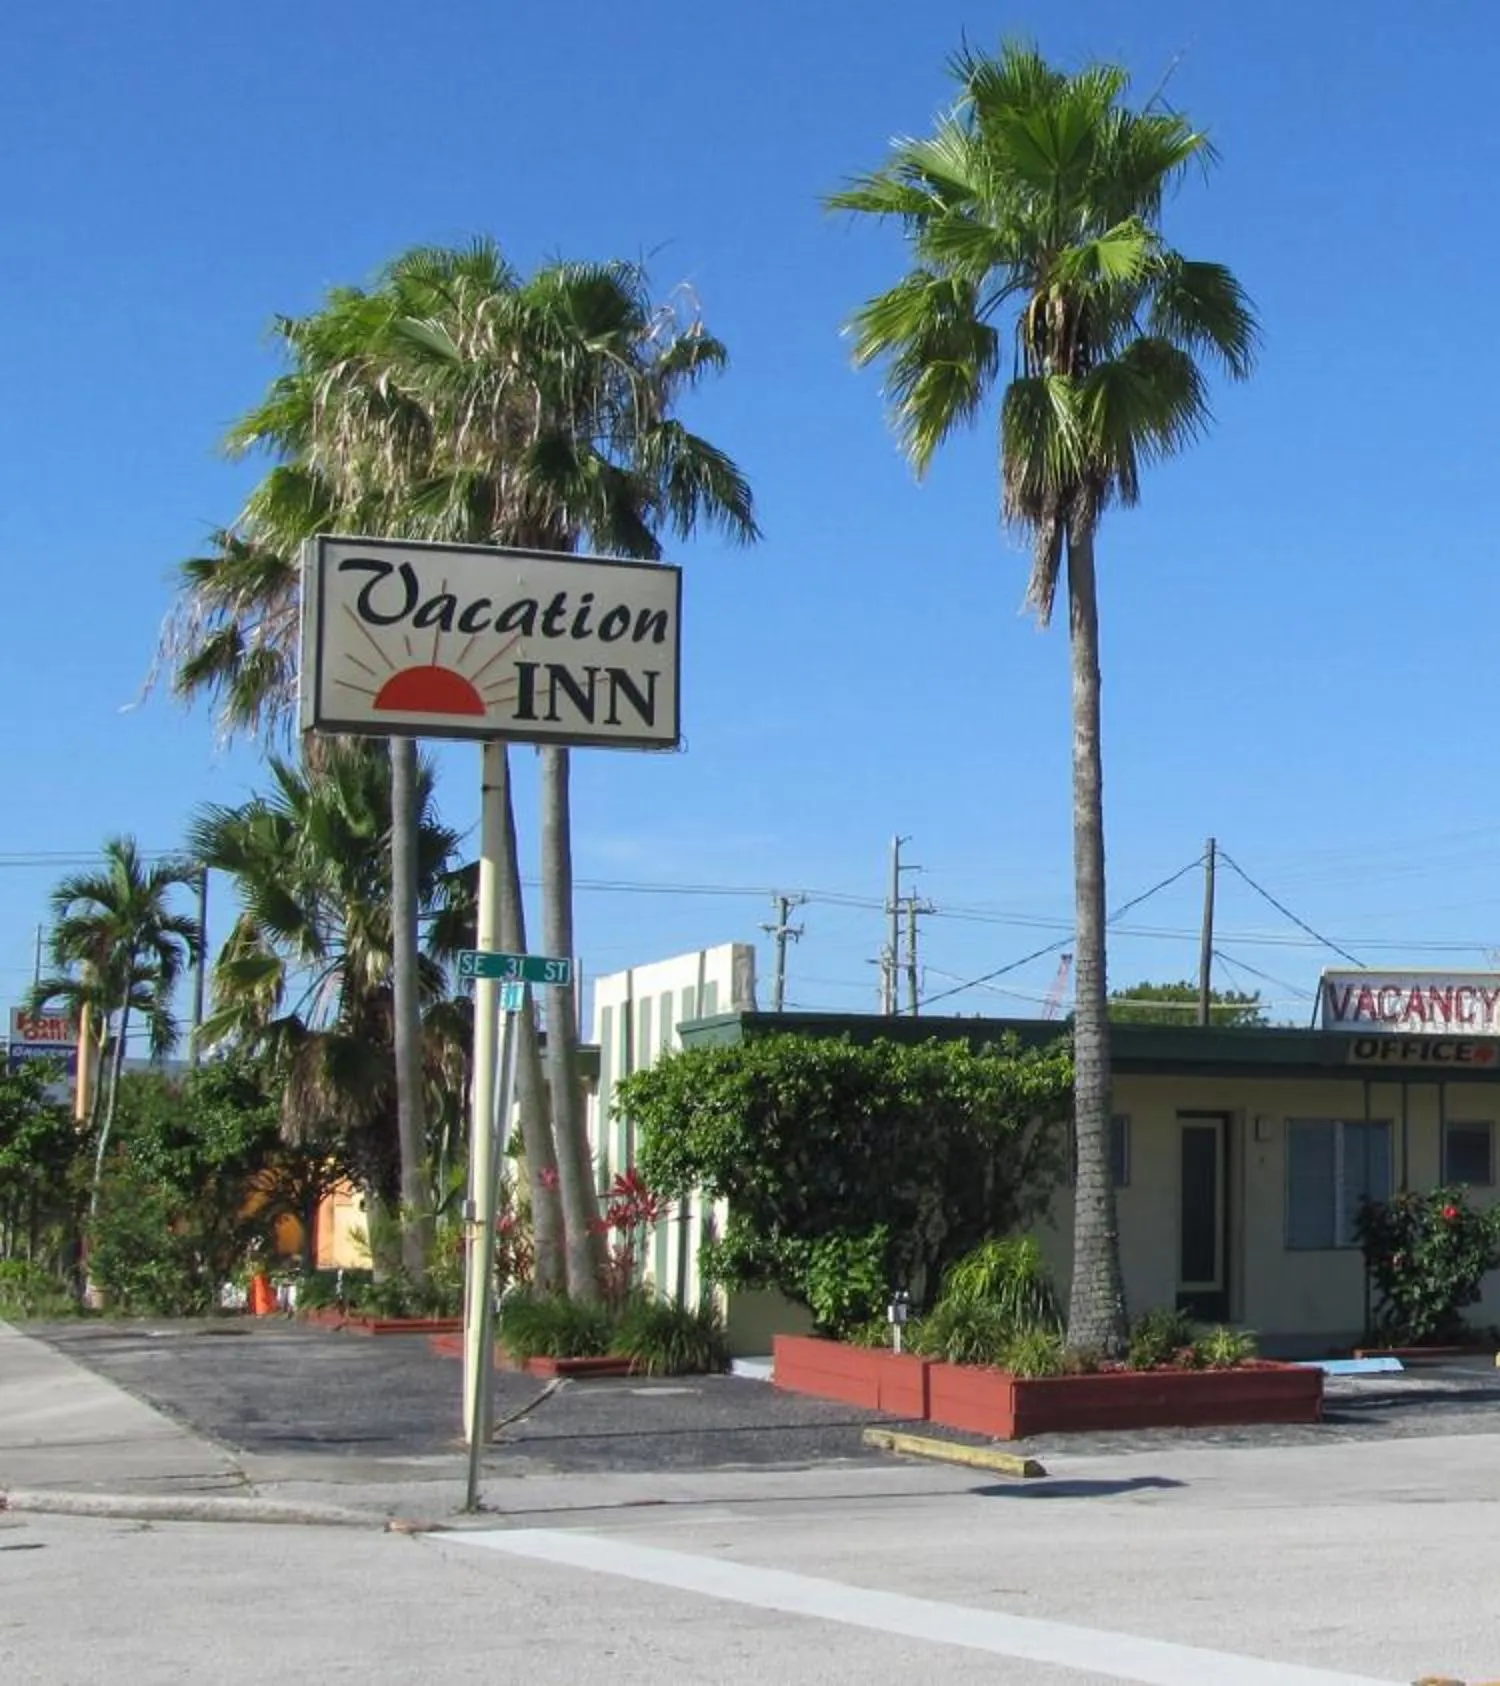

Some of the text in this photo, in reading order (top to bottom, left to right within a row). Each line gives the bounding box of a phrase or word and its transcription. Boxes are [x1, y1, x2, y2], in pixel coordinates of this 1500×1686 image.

[337, 558, 669, 643] Vacation
[512, 661, 660, 727] INN
[461, 953, 488, 975] SE
[544, 961, 566, 981] ST
[1354, 1038, 1475, 1062] OFFICE
